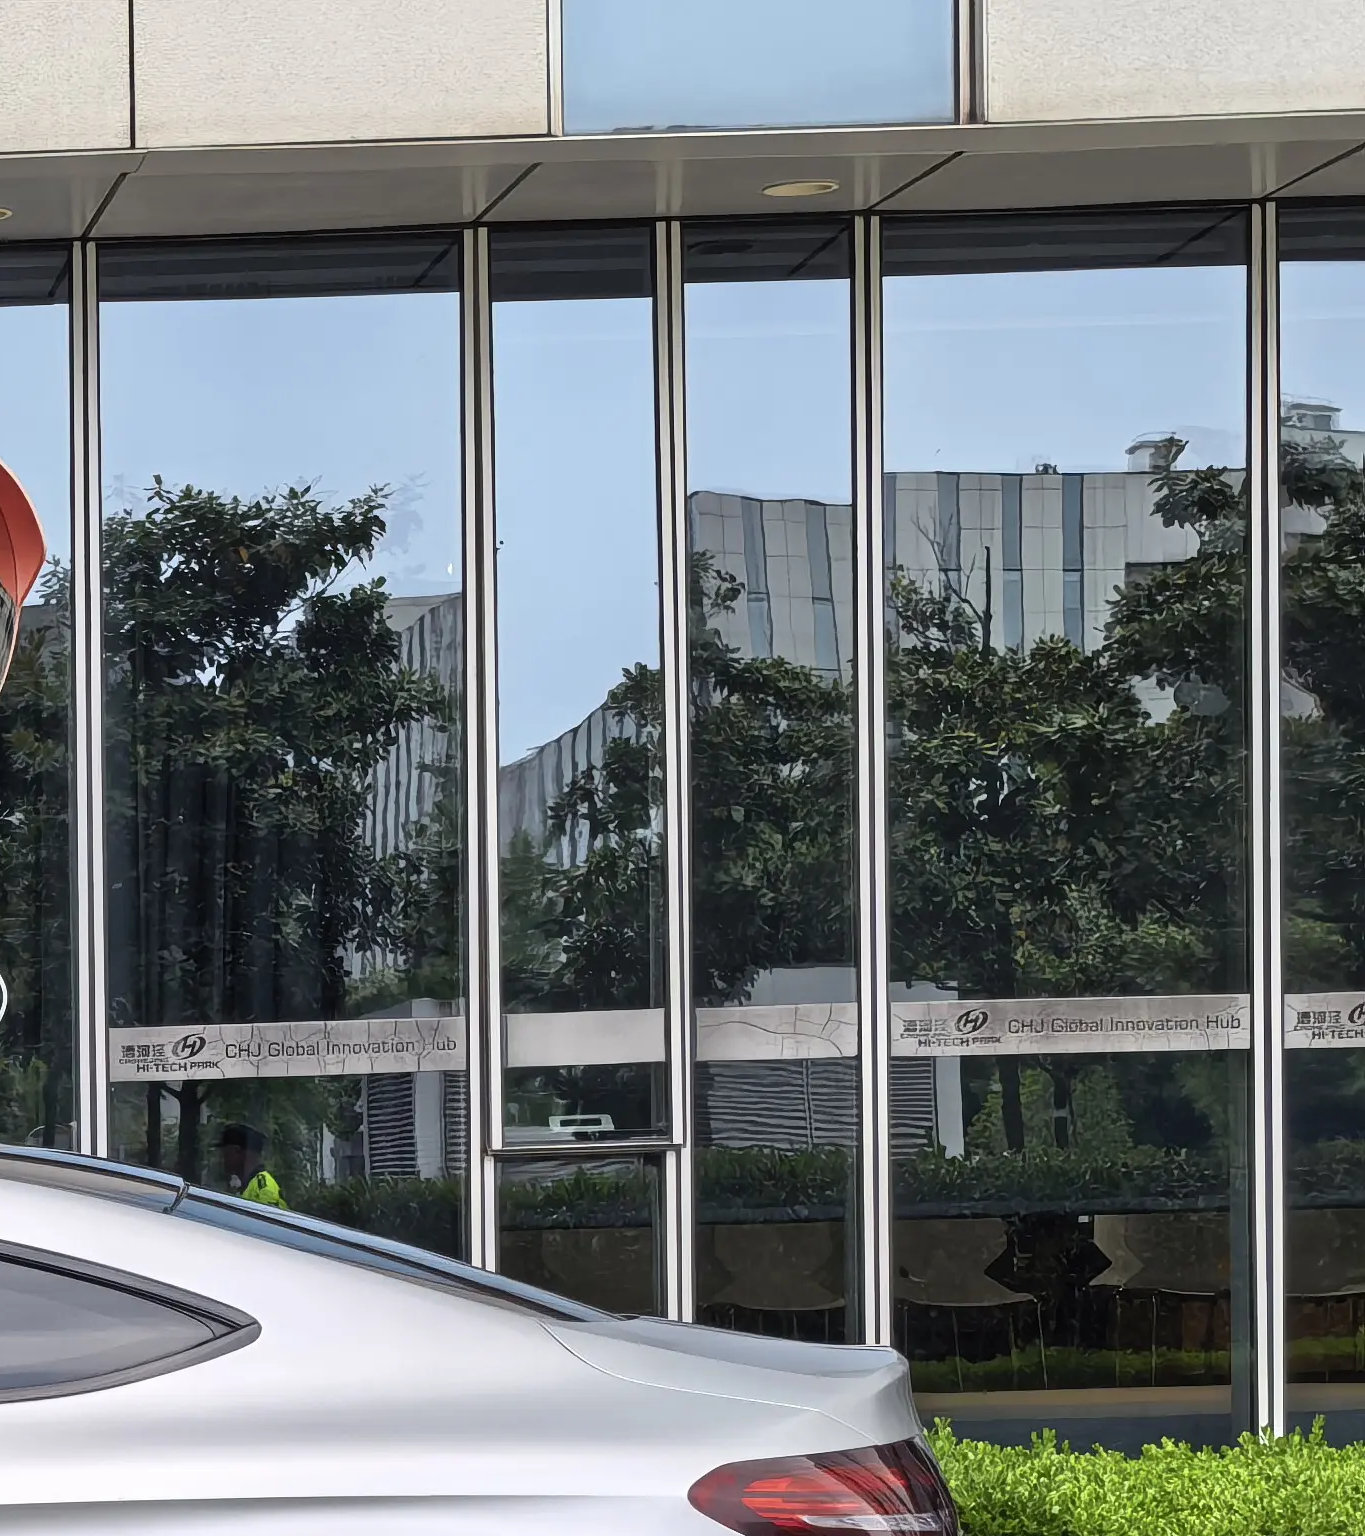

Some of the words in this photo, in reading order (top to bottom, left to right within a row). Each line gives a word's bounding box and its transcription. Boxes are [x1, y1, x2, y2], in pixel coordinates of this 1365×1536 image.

[1008, 1018, 1045, 1034] CHJ
[1051, 1018, 1103, 1033] Global
[1110, 1016, 1199, 1031] Innovation
[1206, 1014, 1241, 1030] Hub
[225, 1043, 261, 1058] CHJ
[268, 1041, 320, 1057] Global
[326, 1040, 415, 1055] Innovation
[190, 1061, 220, 1070] PARK
